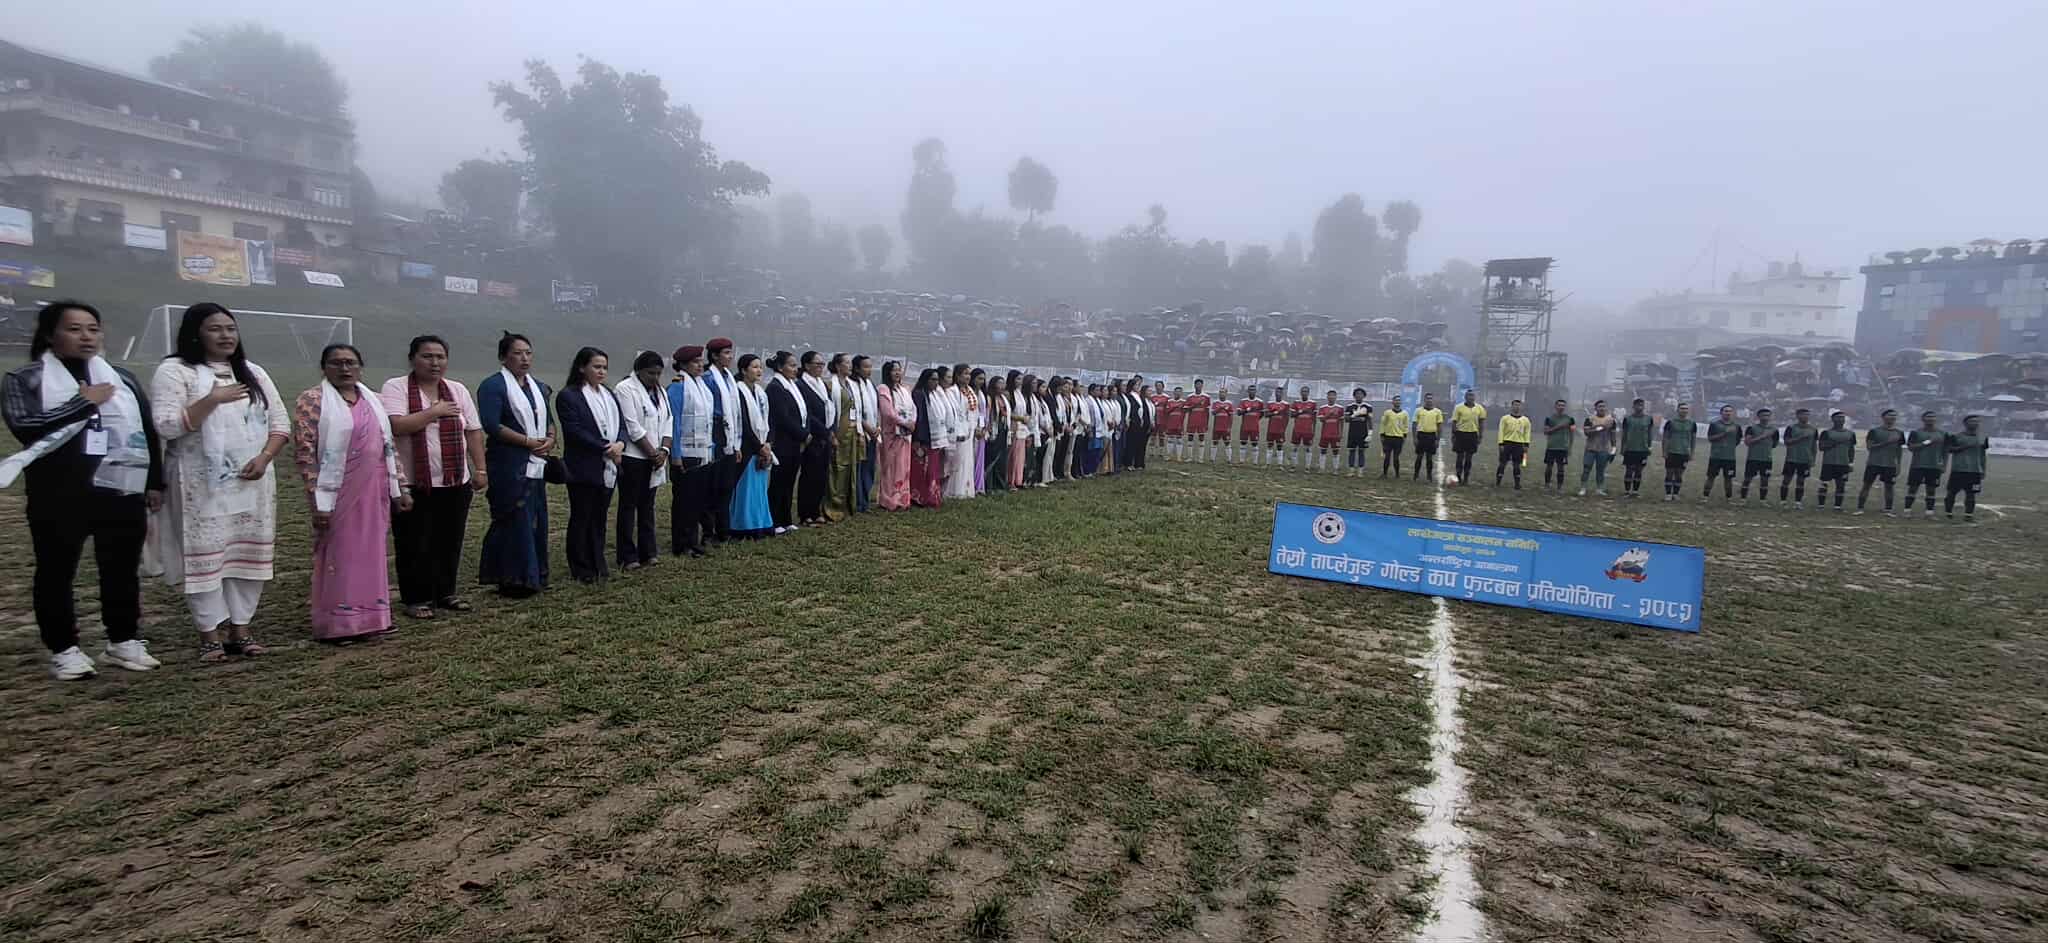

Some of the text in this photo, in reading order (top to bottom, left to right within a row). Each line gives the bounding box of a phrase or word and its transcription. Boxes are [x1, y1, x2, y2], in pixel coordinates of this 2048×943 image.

[1311, 553, 1376, 582] ताप्लेजुङ
[1380, 560, 1424, 582] गोल्ड
[1428, 569, 1459, 588] कप
[1463, 574, 1522, 599] फुटबल
[1528, 580, 1615, 609] प्रतियोगिता
